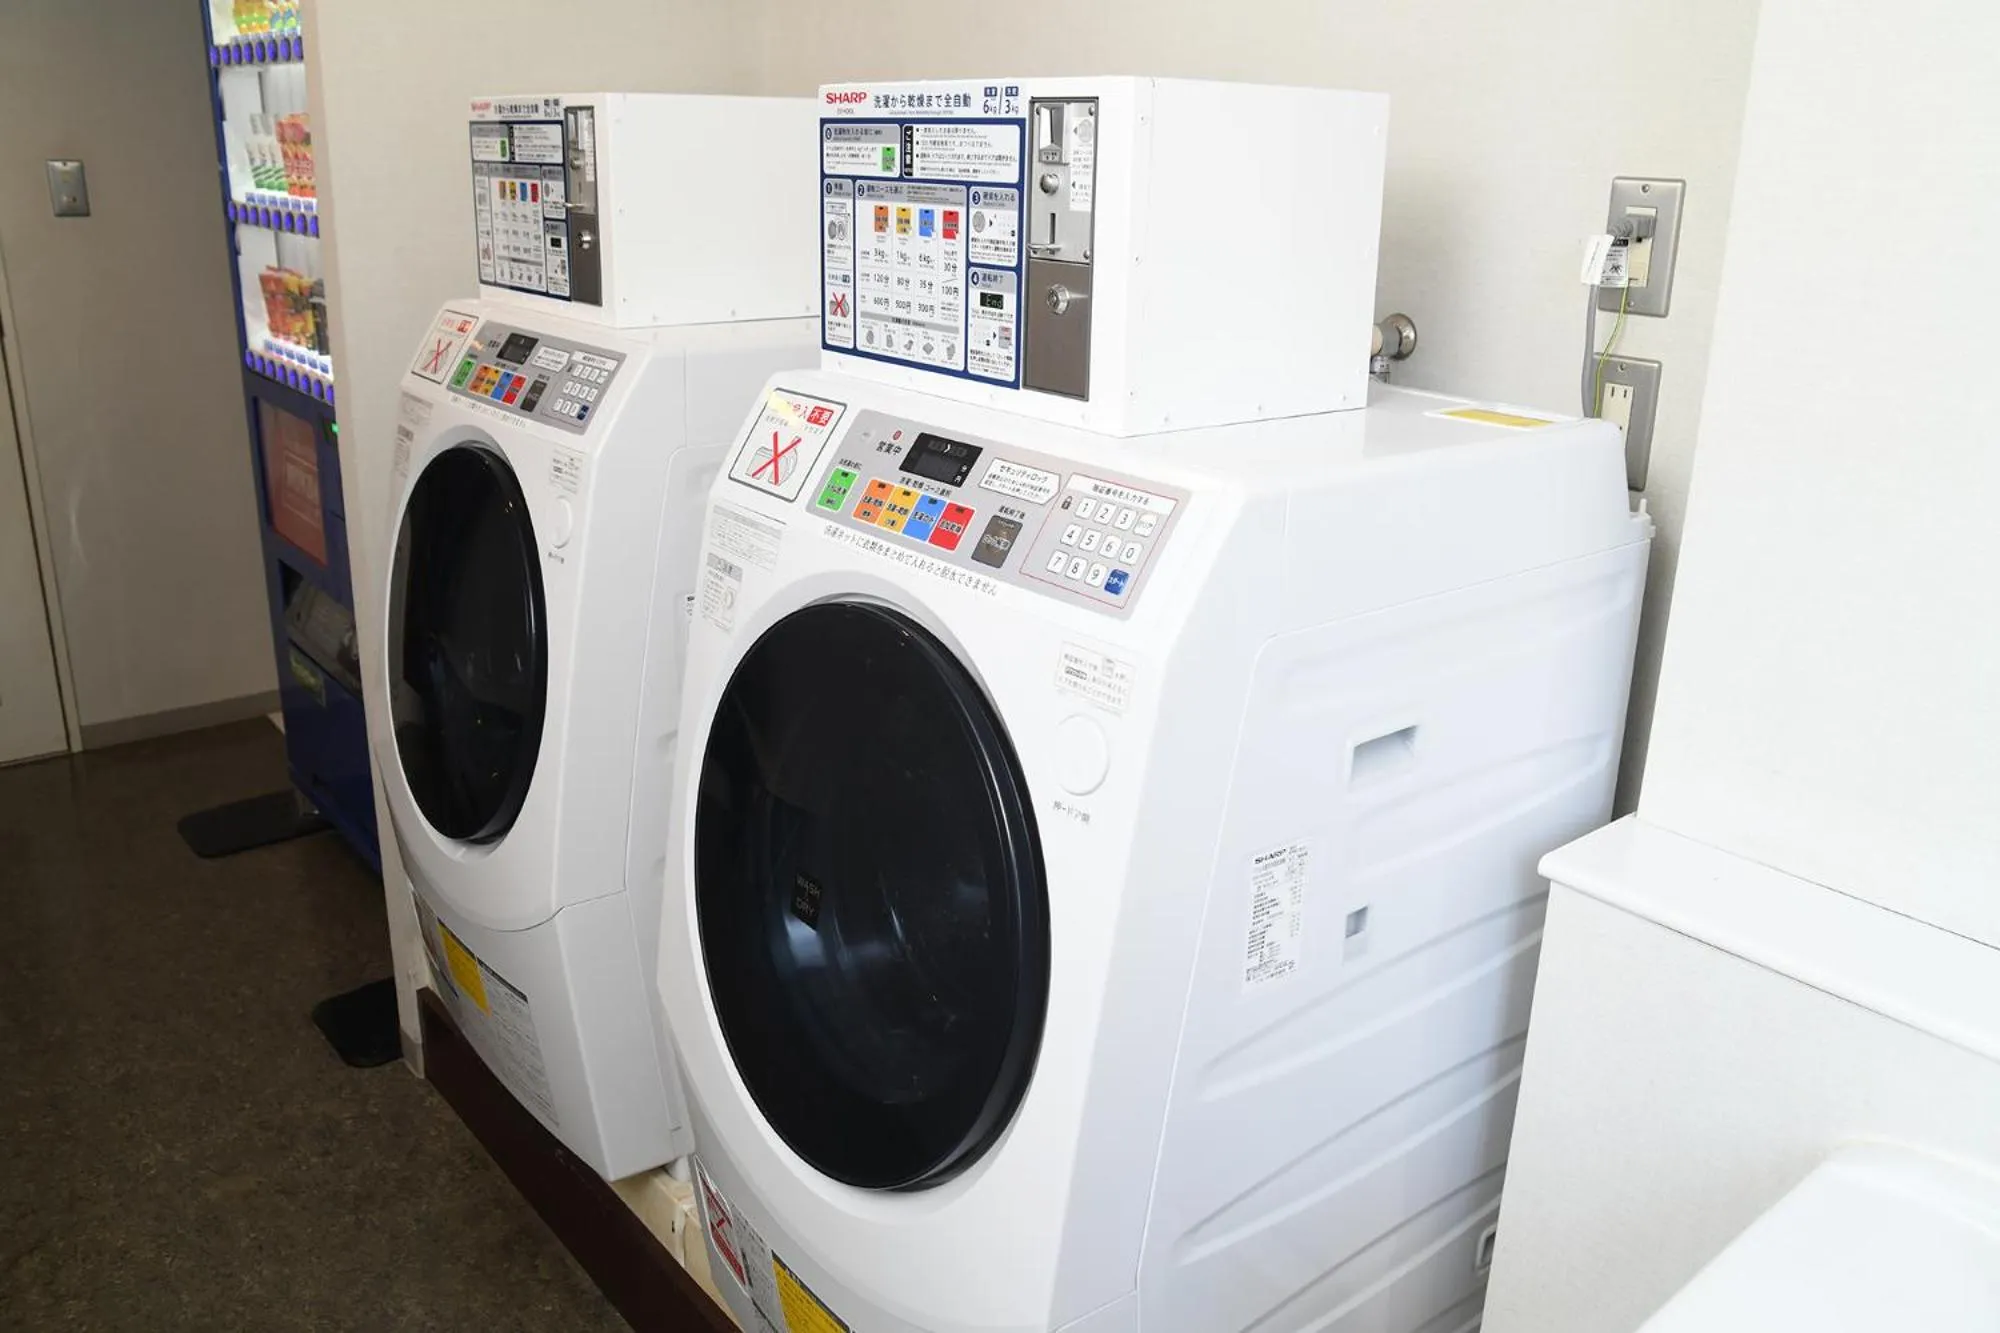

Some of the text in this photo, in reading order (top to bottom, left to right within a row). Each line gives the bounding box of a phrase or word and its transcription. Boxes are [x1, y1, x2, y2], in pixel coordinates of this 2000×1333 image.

[826, 92, 867, 104] SHARP
[874, 93, 972, 109] 洗濯から乾燥まで全自動
[999, 464, 1048, 483] セキュリティロック
[1081, 502, 1089, 513] 1
[1099, 507, 1109, 519] 2
[1120, 513, 1128, 525] 3
[1066, 529, 1075, 541] 4
[1085, 534, 1095, 546] 5
[1105, 539, 1114, 551] 6
[1053, 556, 1062, 567] 7
[1071, 562, 1080, 575] 8
[1092, 568, 1101, 581] 9
